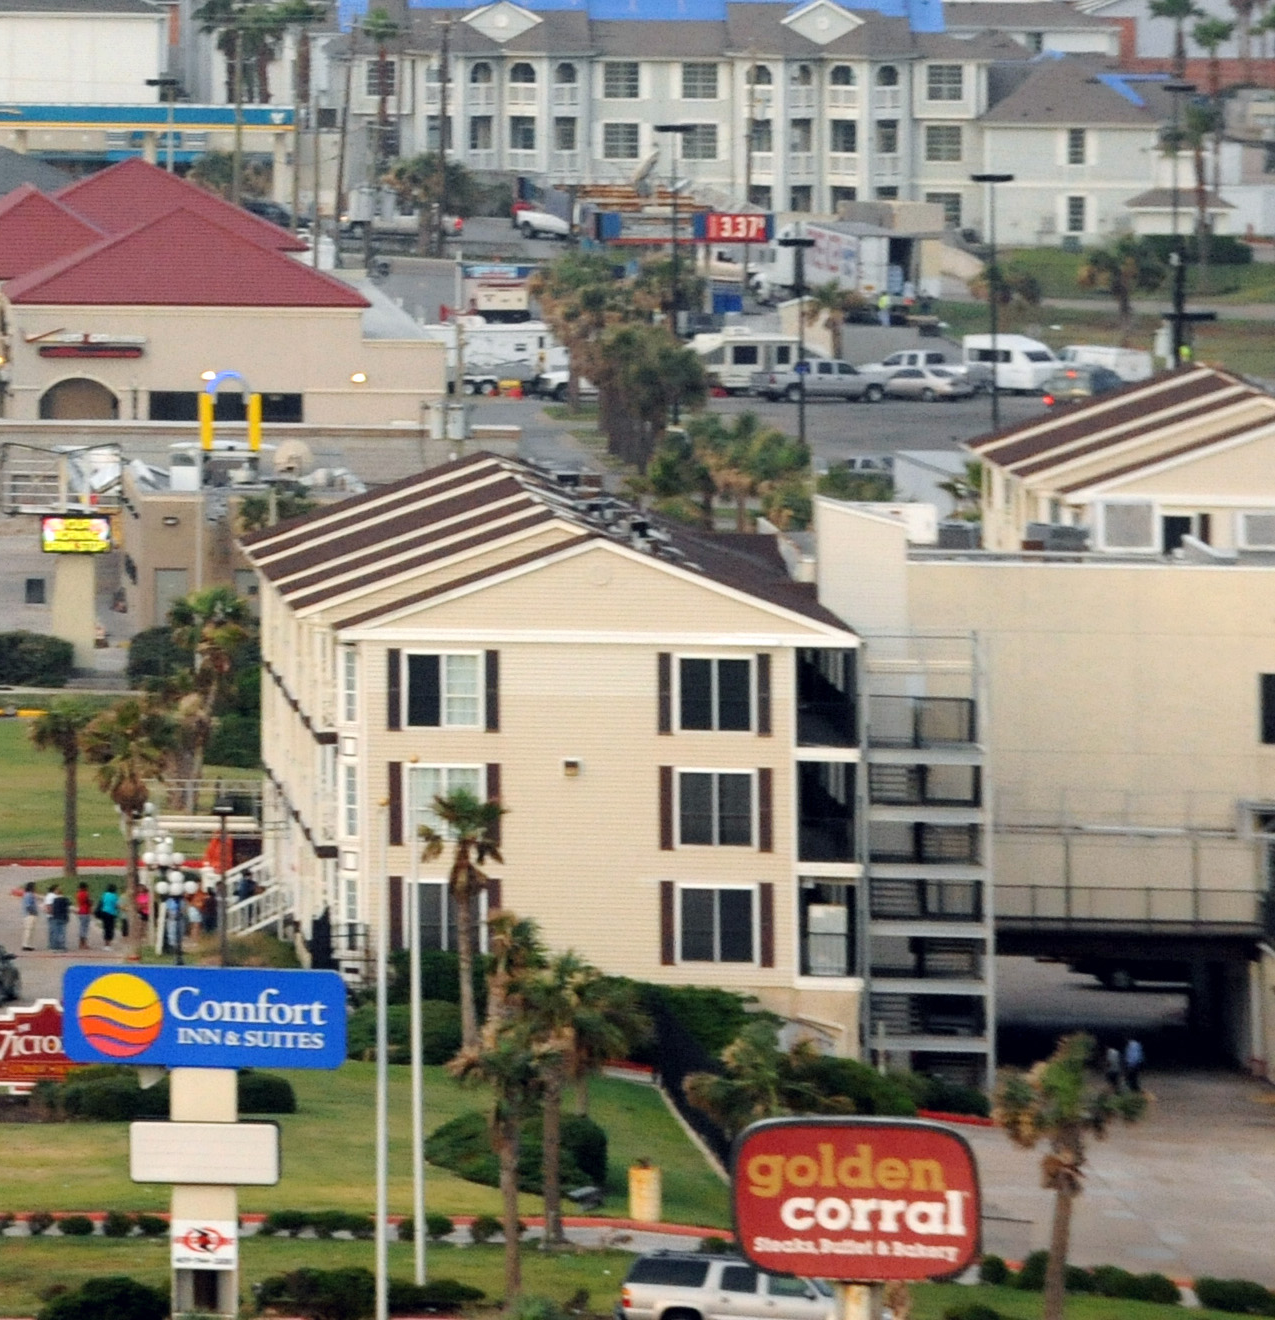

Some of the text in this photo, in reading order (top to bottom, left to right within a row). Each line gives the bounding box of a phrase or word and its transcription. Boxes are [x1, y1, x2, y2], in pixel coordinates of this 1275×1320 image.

[168, 986, 327, 1025] Comfort
[177, 1027, 325, 1049] INN & SUITES
[748, 1143, 946, 1197] golden
[780, 1190, 967, 1236] corral
